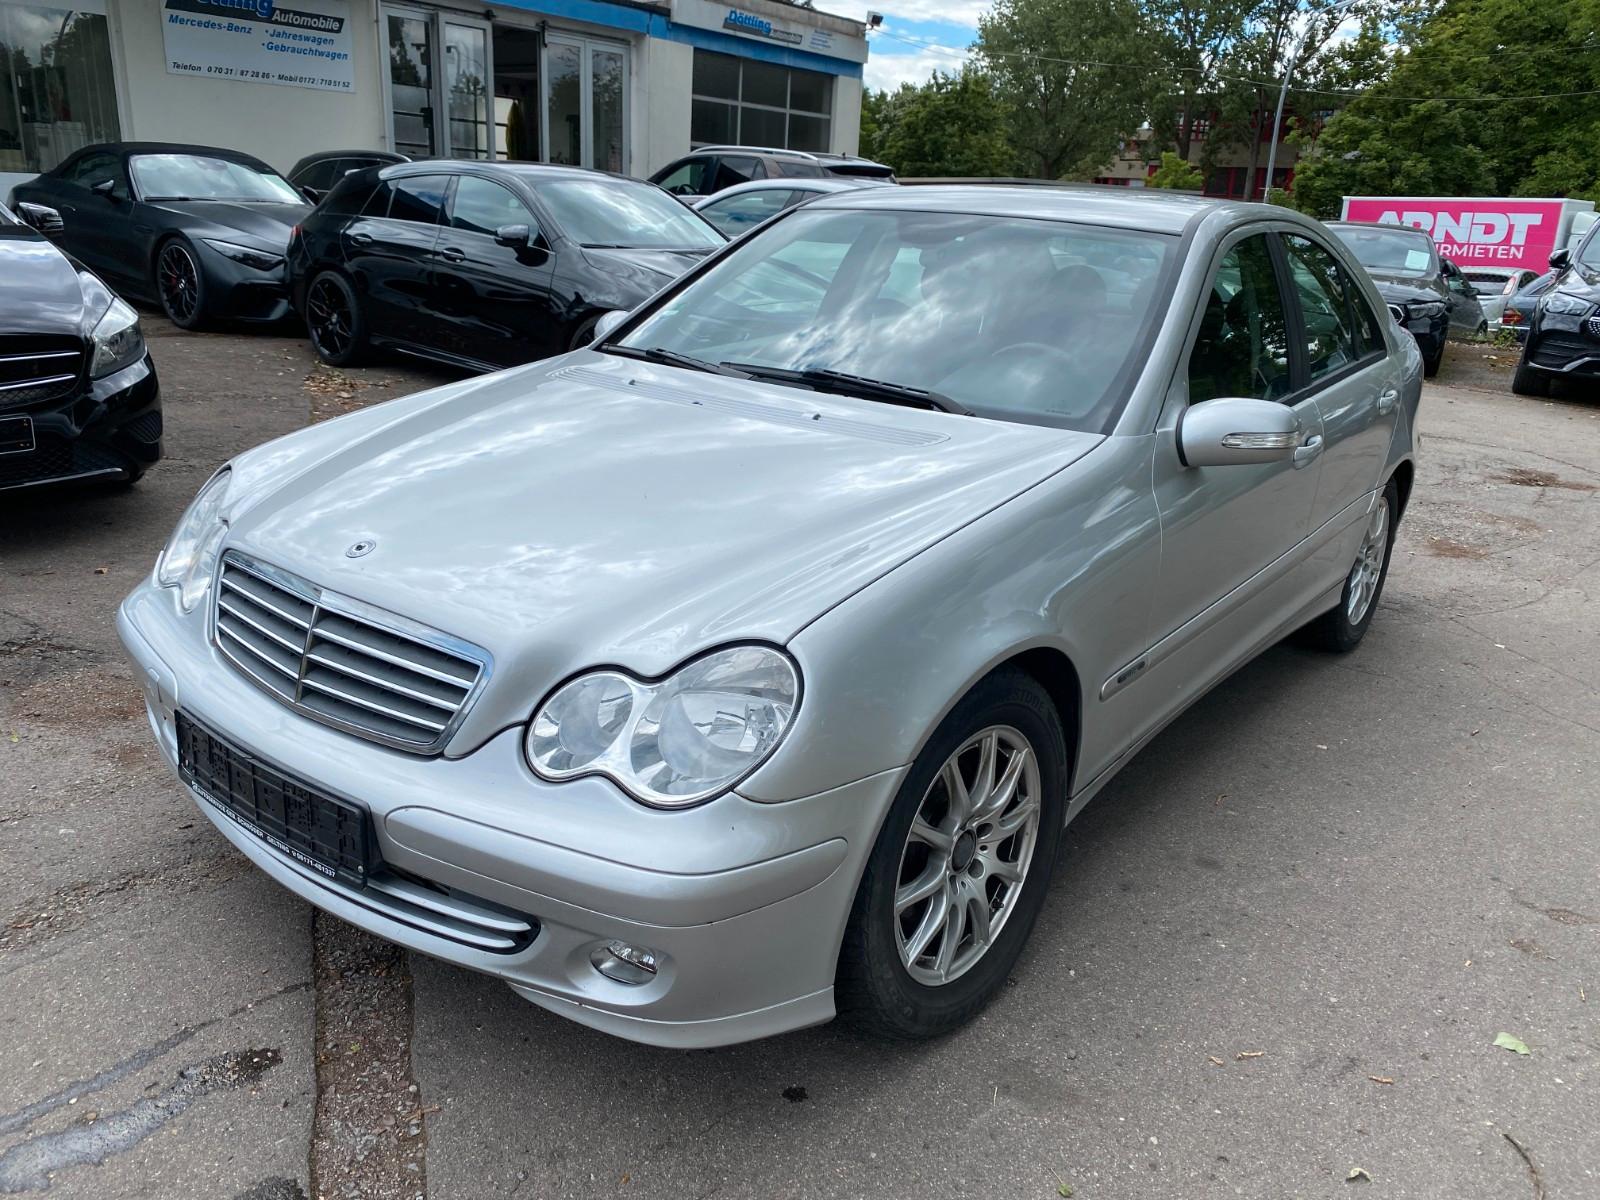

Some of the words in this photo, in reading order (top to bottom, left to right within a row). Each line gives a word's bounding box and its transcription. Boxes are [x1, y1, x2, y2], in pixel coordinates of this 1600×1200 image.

[168, 14, 253, 34] Mercedes-Benz
[269, 29, 335, 46] Jahreswagen
[272, 10, 340, 30] Automobile
[728, 9, 772, 33] Döttling
[266, 41, 349, 61] Gebrauchtwagen
[172, 61, 202, 72] Telefon
[277, 74, 298, 82] Mobil
[1436, 244, 1524, 259] RMIETEN
